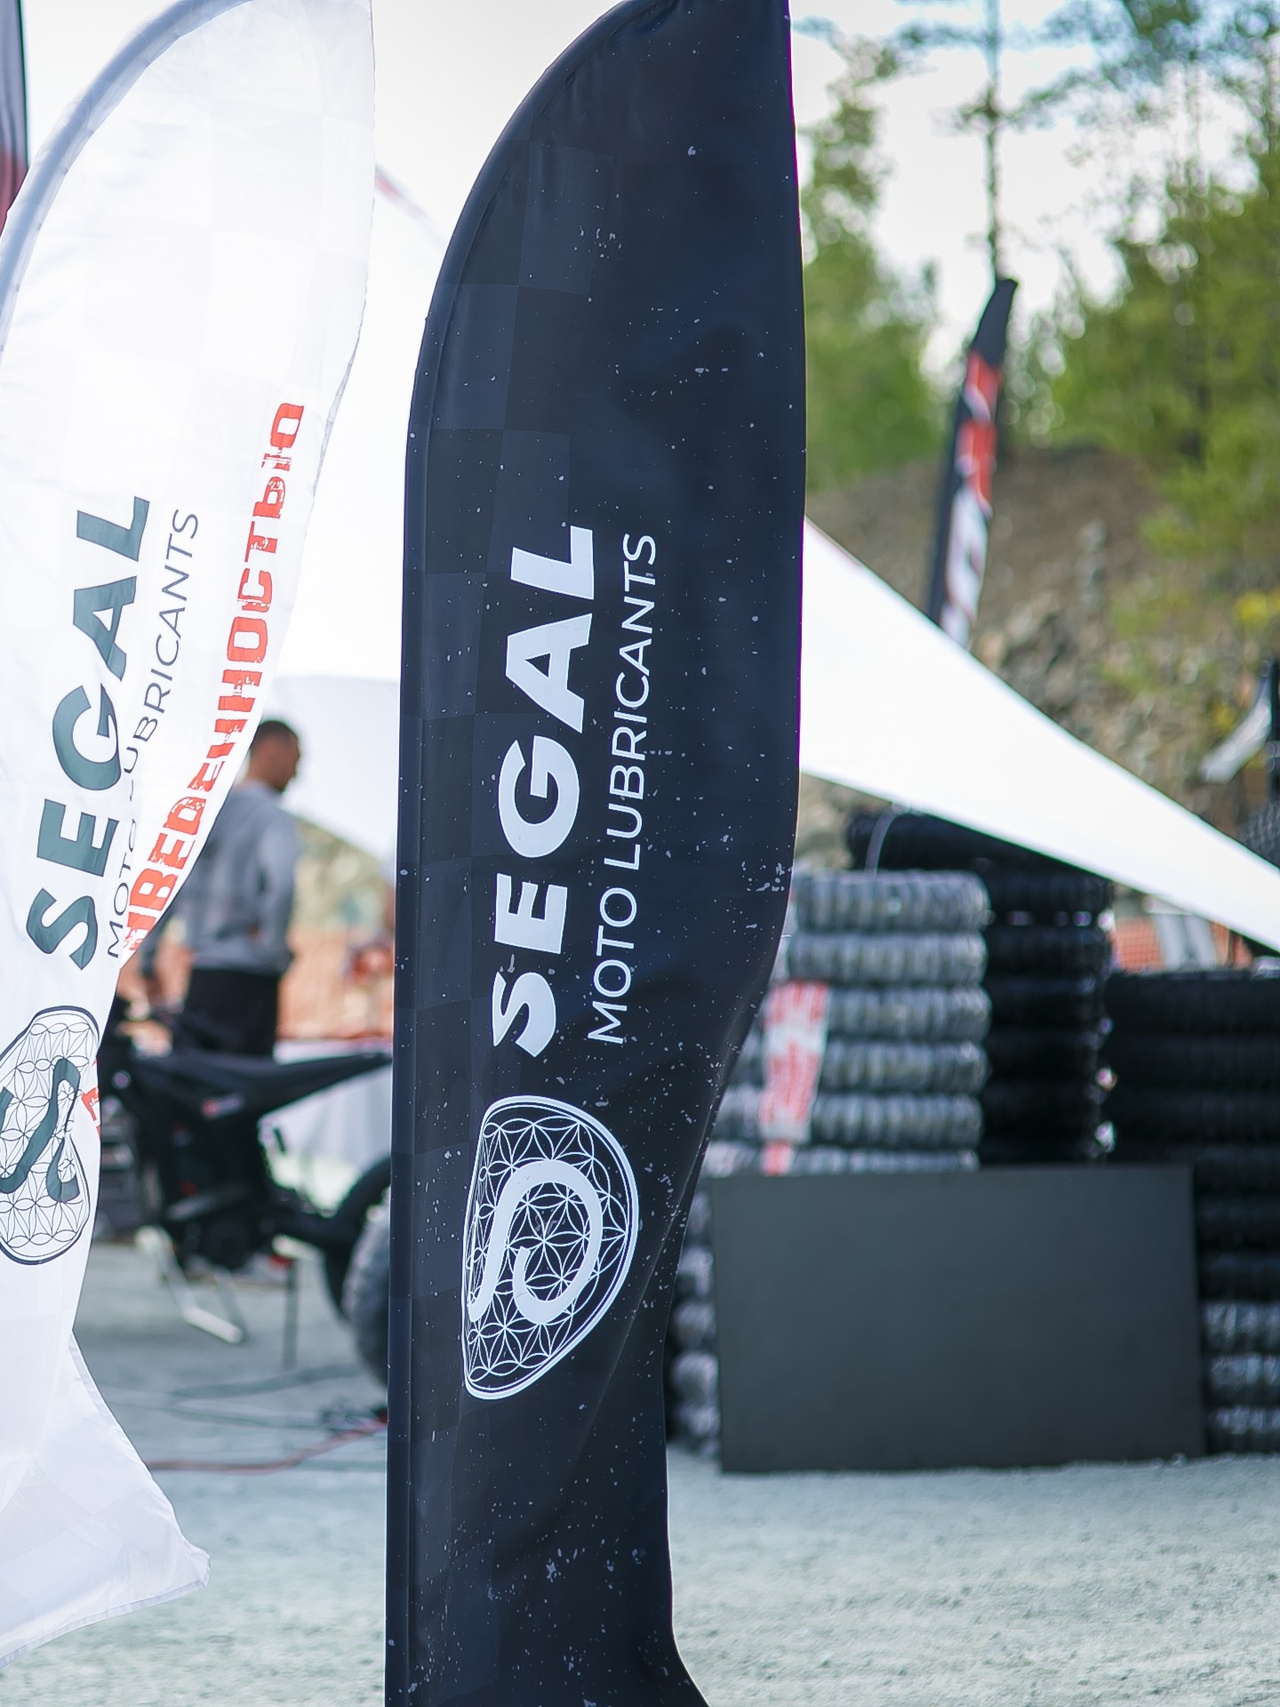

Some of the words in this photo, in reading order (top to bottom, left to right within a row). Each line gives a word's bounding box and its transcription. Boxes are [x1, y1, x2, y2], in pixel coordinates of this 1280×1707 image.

[25, 497, 150, 970] SEGAL
[492, 525, 595, 1058] SEGAL
[604, 532, 657, 871] LUBRICANTS
[587, 887, 638, 1044] MOTO
